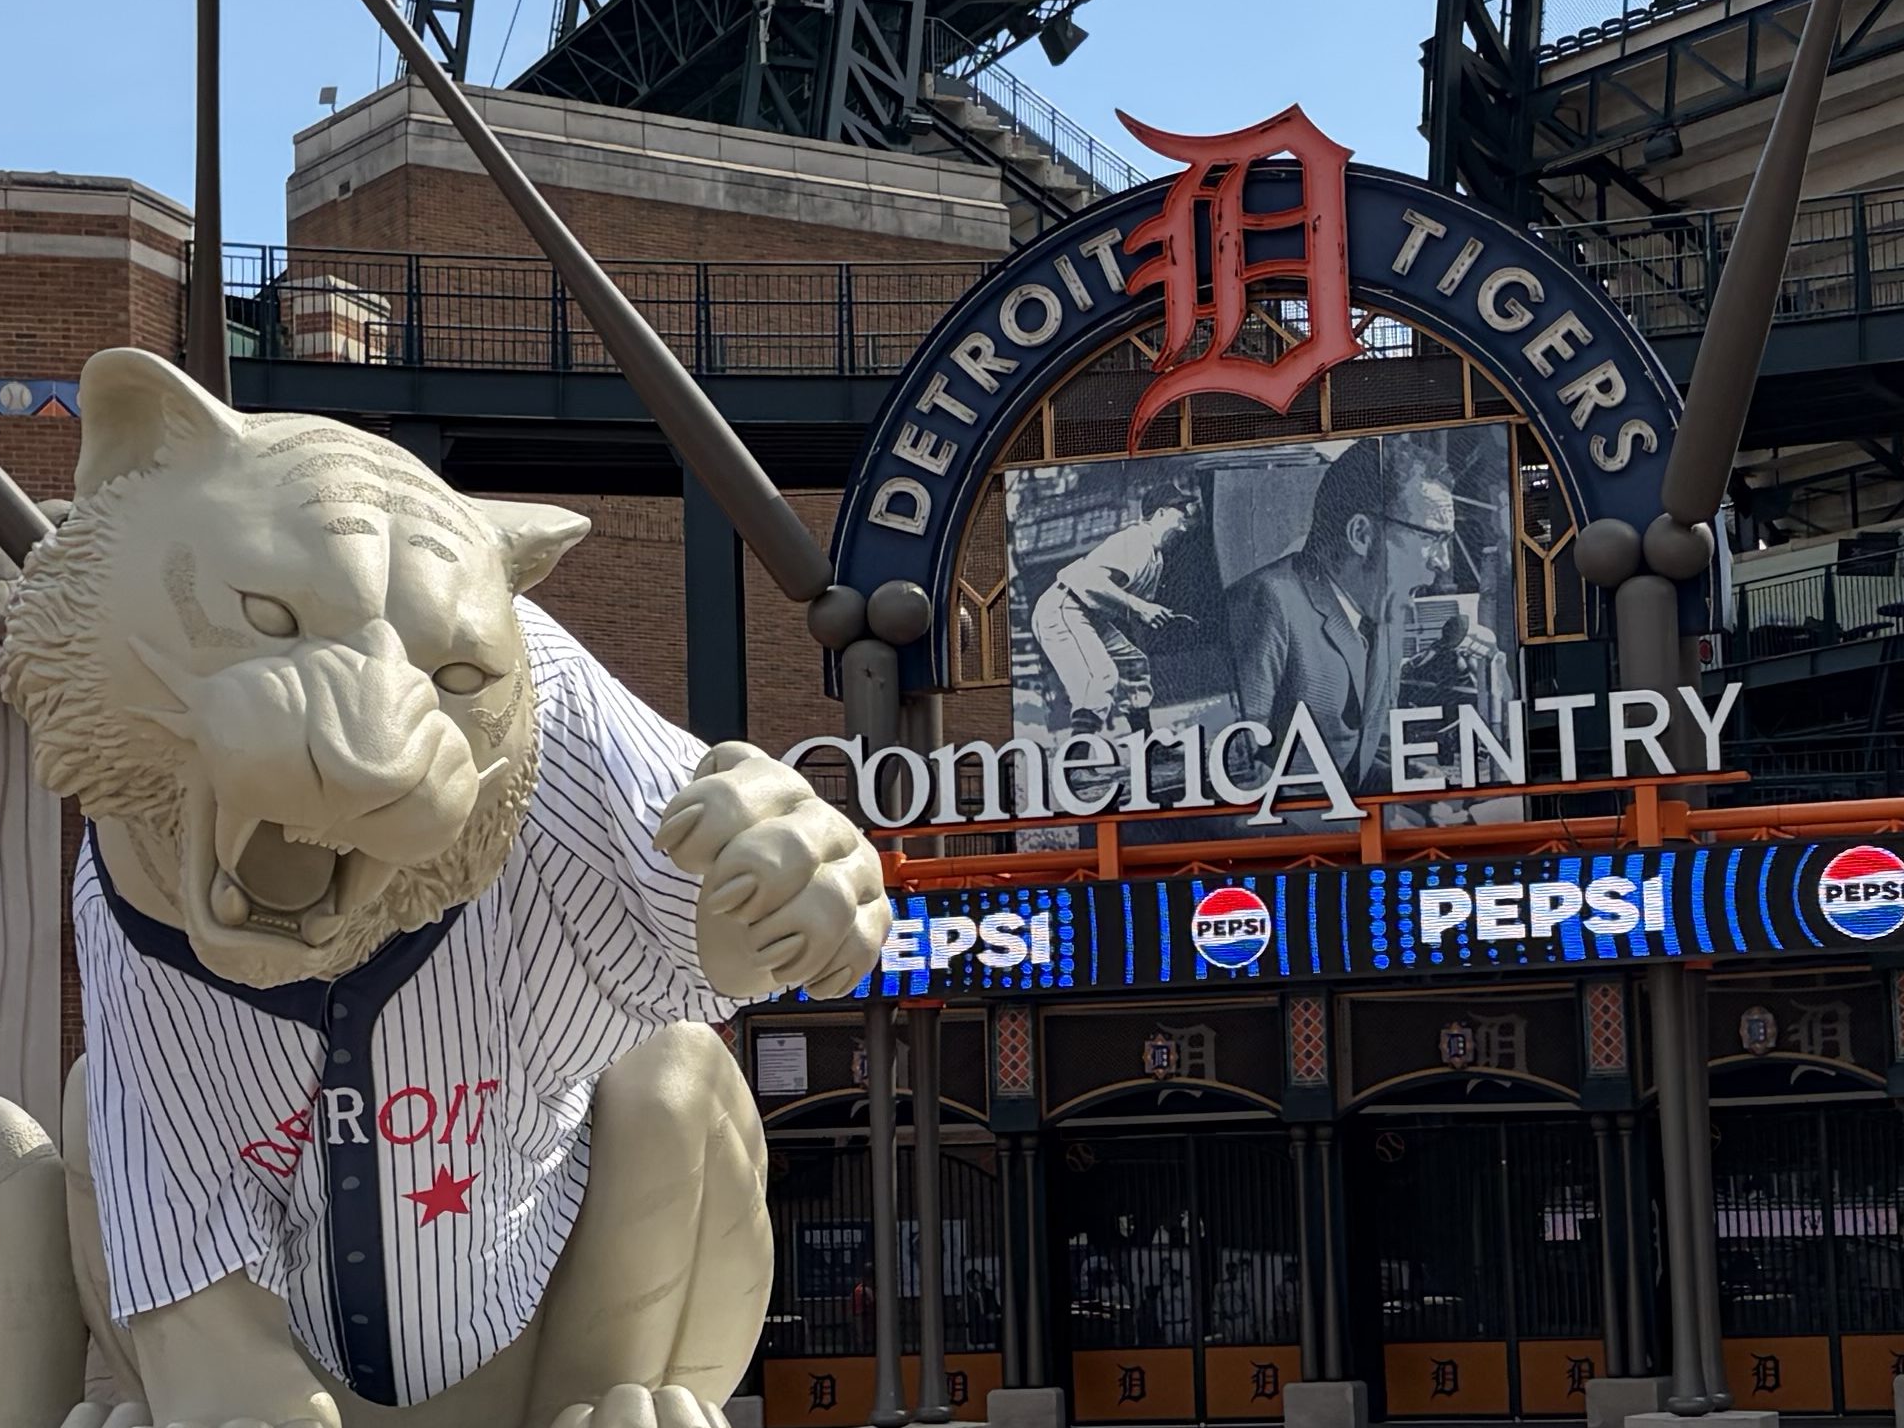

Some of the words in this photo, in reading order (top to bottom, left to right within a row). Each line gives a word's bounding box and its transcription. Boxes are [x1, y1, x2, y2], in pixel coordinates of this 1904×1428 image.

[867, 225, 1127, 538] DETROIT
[1389, 207, 1660, 476] TIGERS
[1389, 682, 1742, 794] ENTRY
[881, 912, 1051, 973] EPSI
[1196, 918, 1266, 937] PEPSI
[1418, 873, 1666, 945] PEPSI
